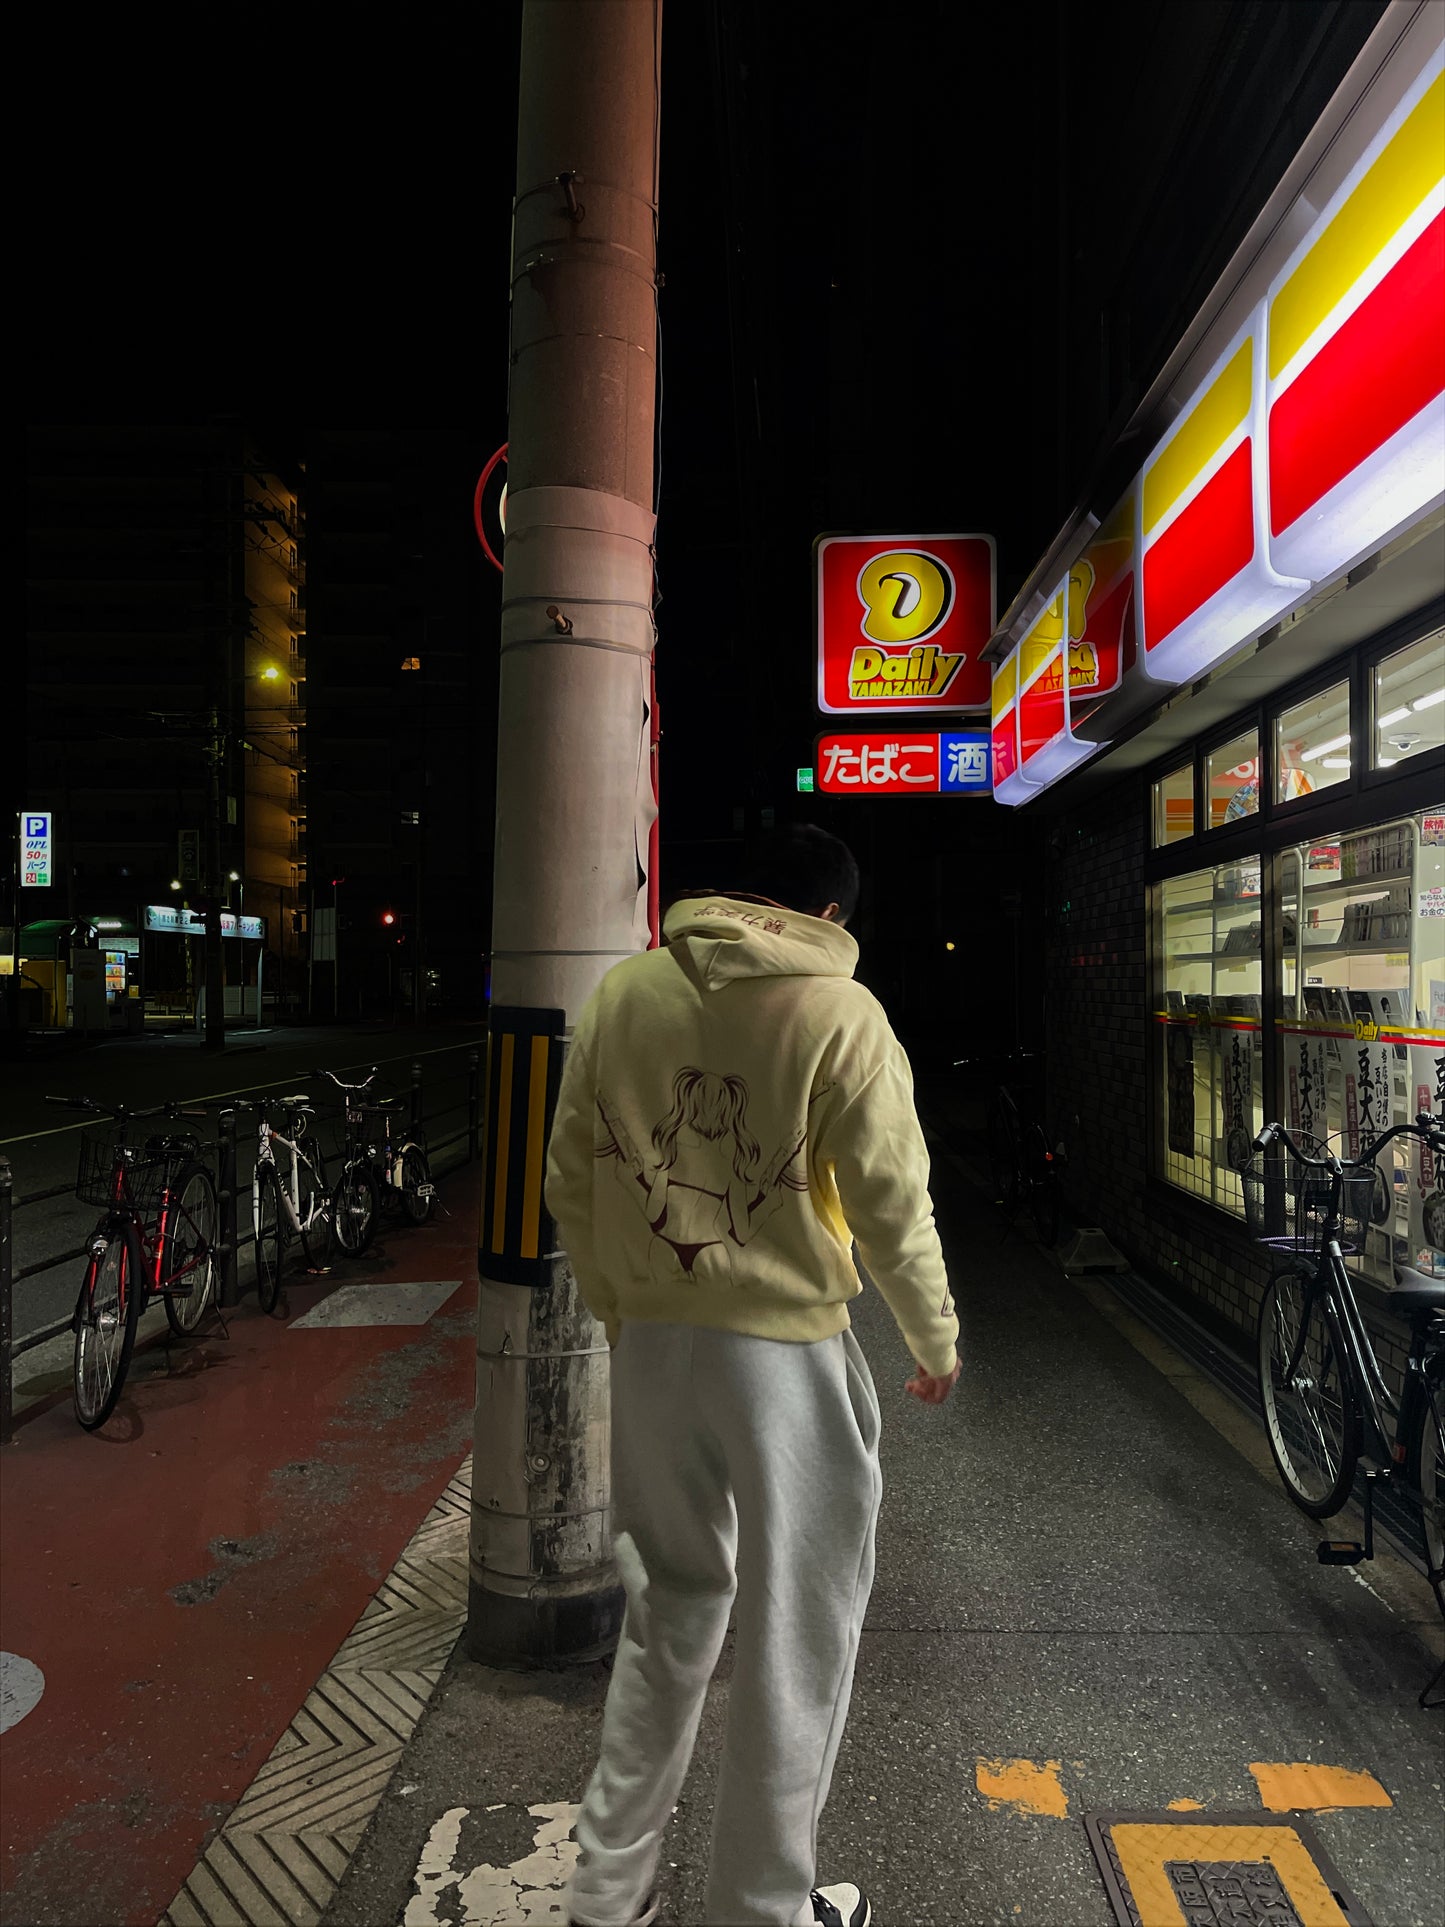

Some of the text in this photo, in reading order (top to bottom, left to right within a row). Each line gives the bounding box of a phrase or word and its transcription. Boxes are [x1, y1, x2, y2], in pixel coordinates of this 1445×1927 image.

[852, 646, 963, 696] Daily
[851, 681, 931, 697] YAMAZAKI
[823, 744, 935, 784] たばこ
[948, 743, 989, 783] 酒
[29, 818, 44, 836] P
[26, 840, 48, 849] OPL
[26, 874, 37, 883] 24
[1213, 1882, 1252, 1918] 水道
